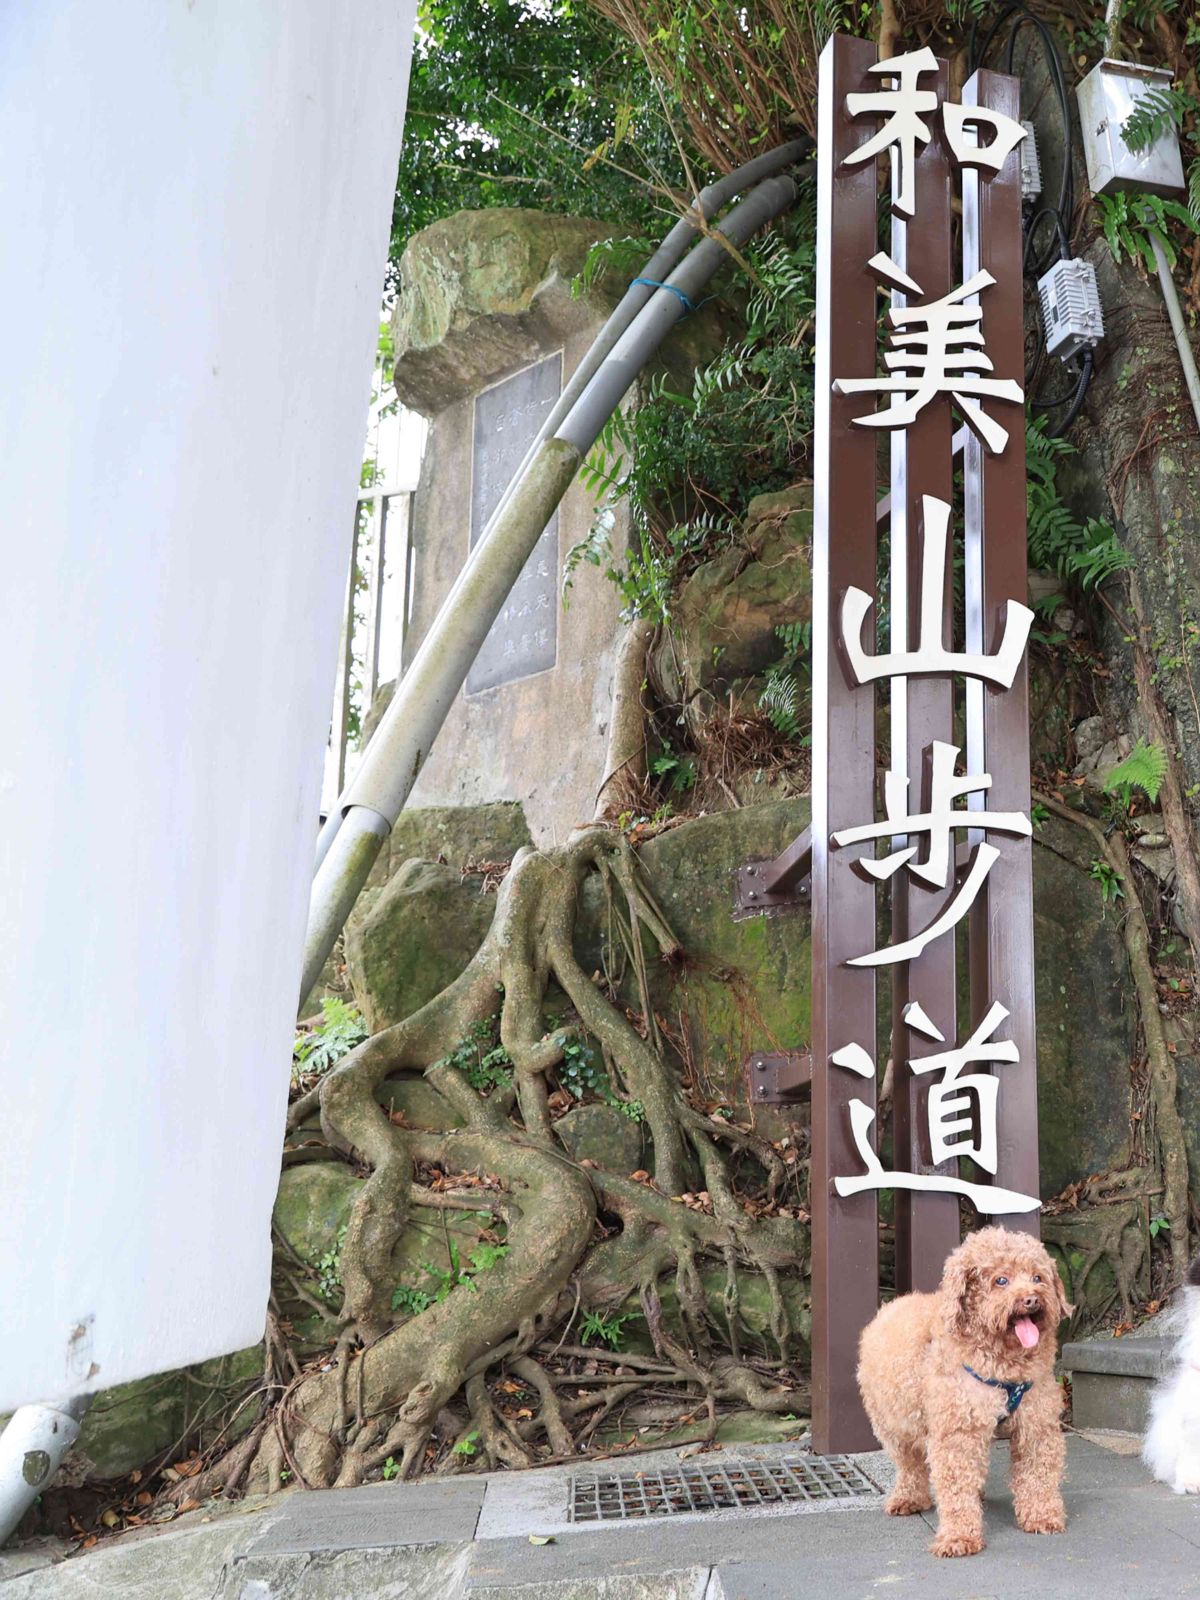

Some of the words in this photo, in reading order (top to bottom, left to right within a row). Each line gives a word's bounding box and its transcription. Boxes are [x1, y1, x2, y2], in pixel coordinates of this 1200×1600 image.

[831, 46, 1042, 1214] 和美山步道
